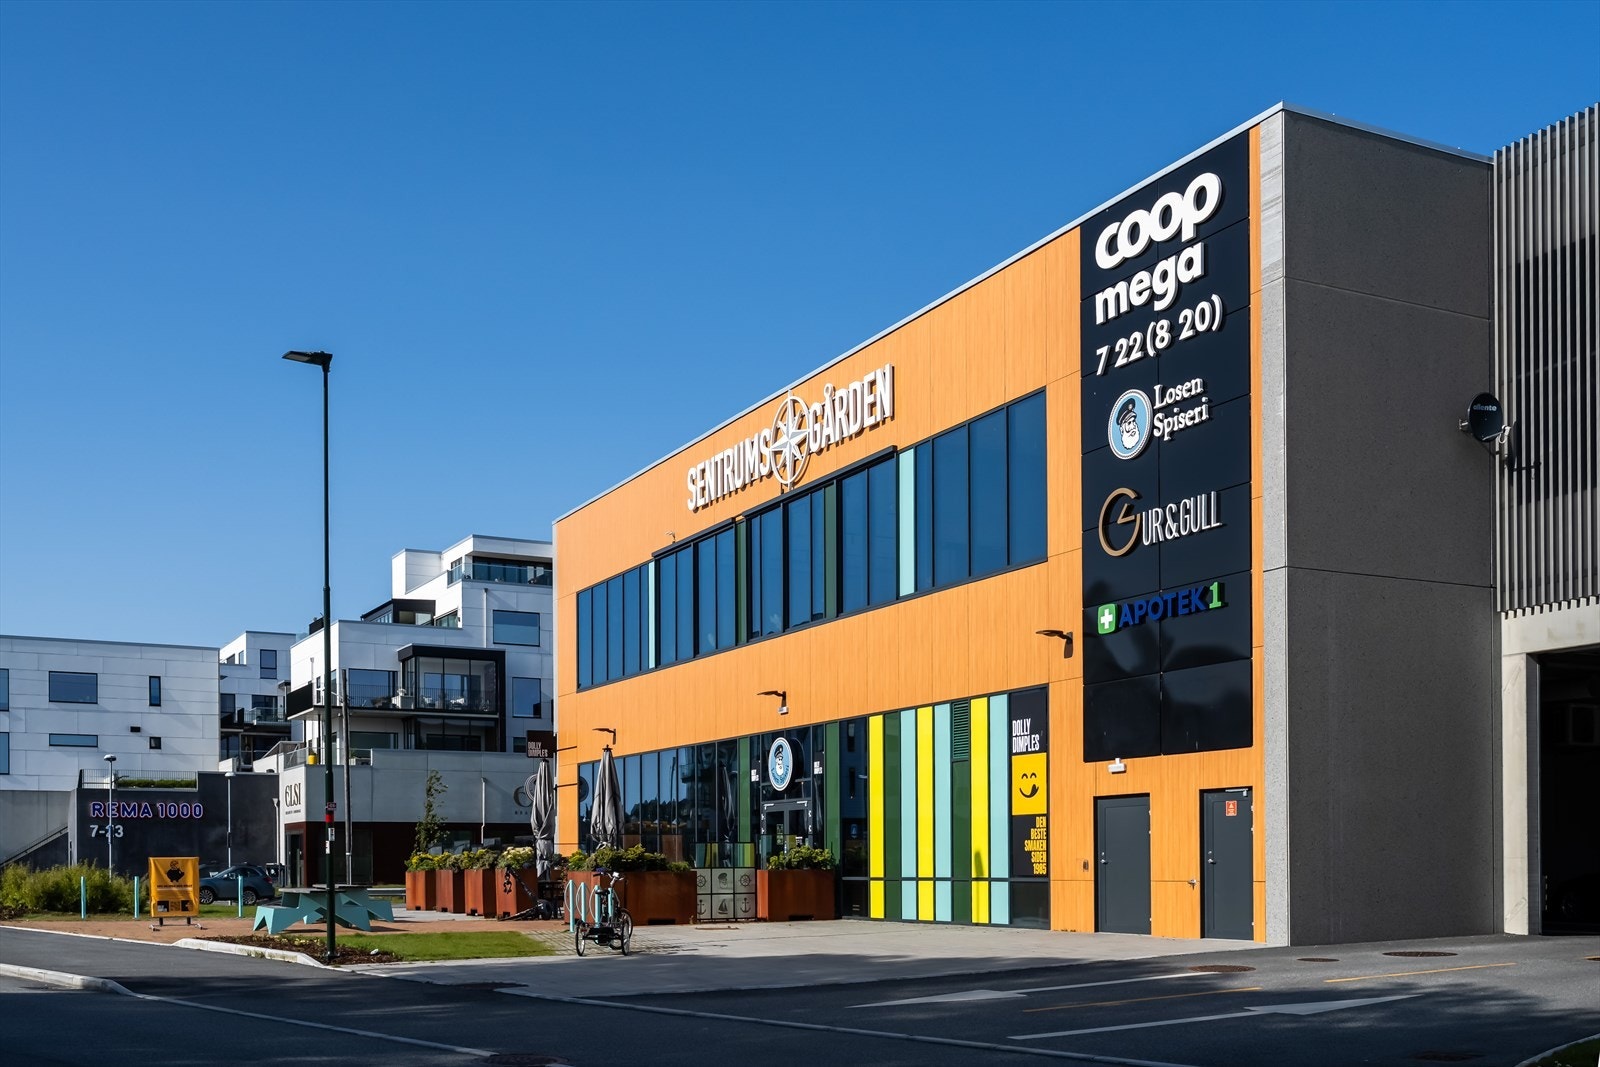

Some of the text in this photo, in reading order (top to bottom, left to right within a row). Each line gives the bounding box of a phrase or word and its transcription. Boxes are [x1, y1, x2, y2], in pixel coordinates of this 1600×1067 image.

[1095, 172, 1222, 269] coop
[1095, 242, 1205, 325] mega
[1096, 344, 1111, 376] 7
[1153, 377, 1205, 410] Losen
[1153, 396, 1209, 441] Spiseri
[687, 363, 894, 512] SENTRUMS GÅRDEN
[1012, 718, 1031, 737] DOLLY
[528, 742, 542, 750] DOLLY
[1012, 734, 1040, 754] DIMPLES
[91, 801, 204, 819] REMA 1000
